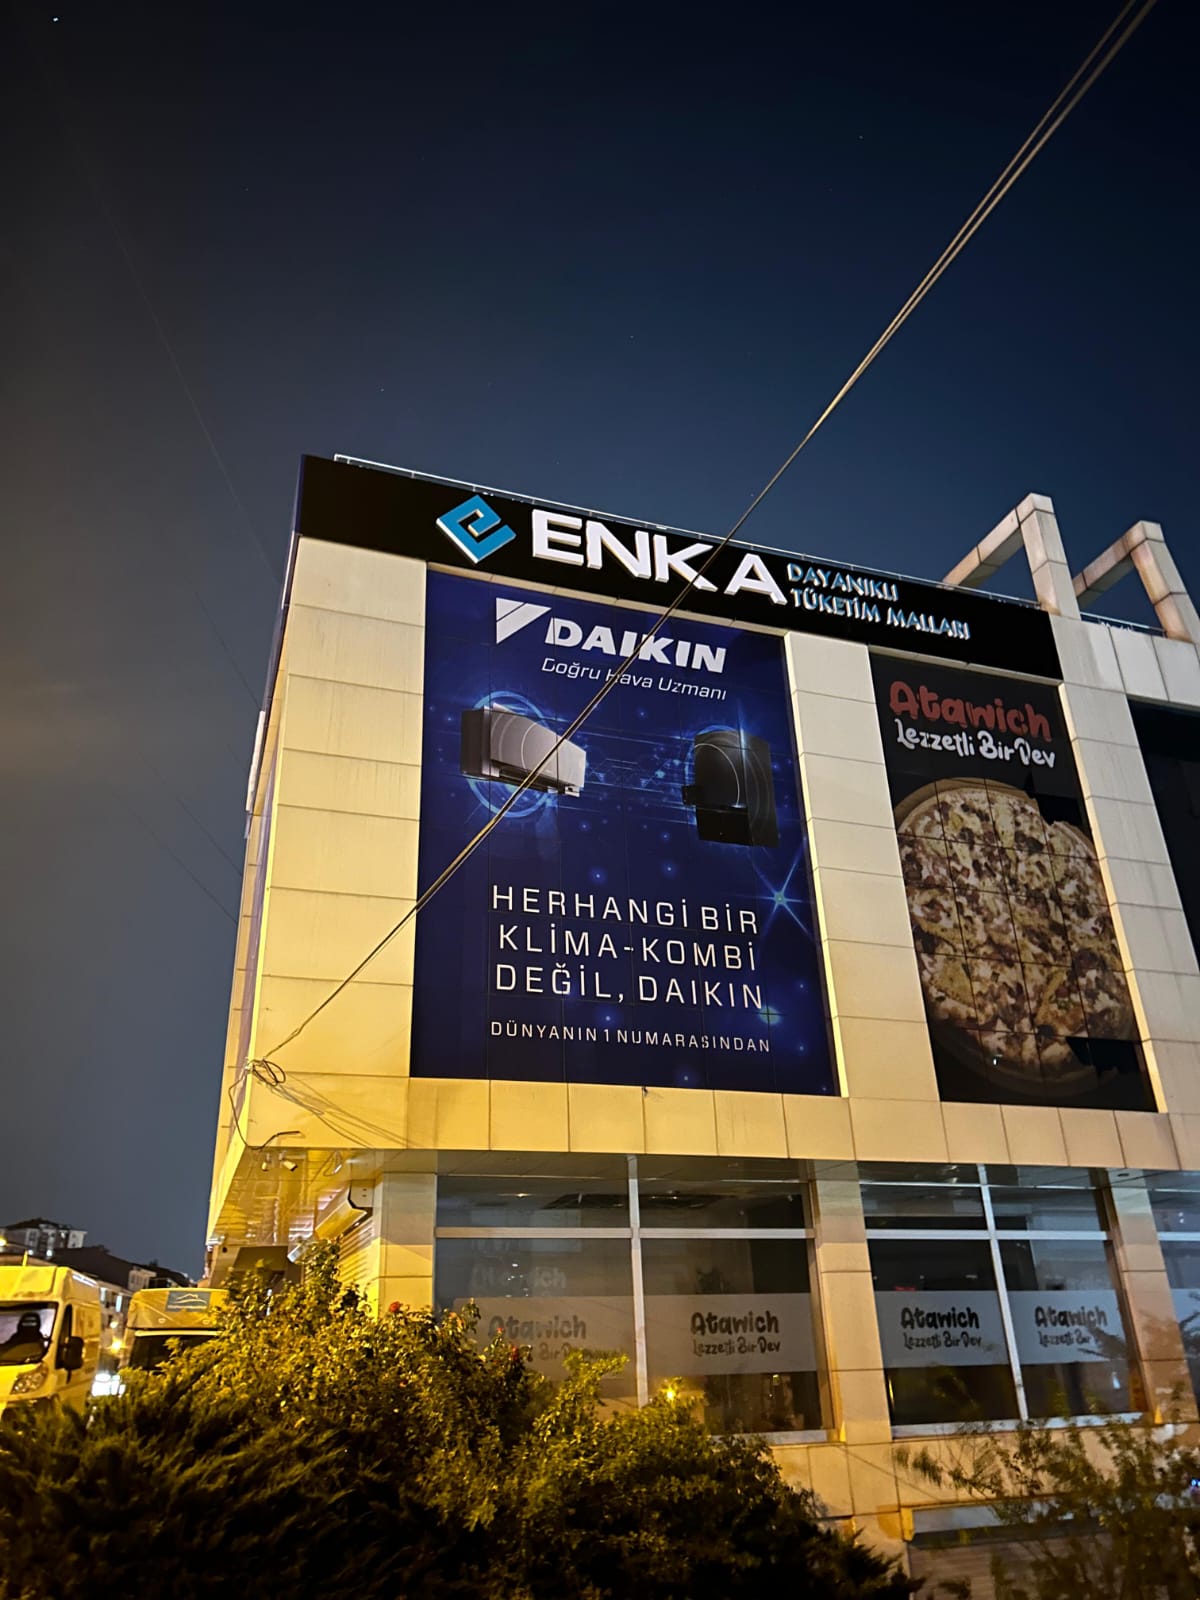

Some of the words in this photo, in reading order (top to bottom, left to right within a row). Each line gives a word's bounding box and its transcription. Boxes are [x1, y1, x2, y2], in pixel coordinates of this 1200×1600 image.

[531, 509, 788, 605] ENKA
[787, 562, 899, 602] DAYANIKLI
[790, 587, 881, 623] TÜKETİM
[886, 607, 971, 640] MALLARI
[545, 618, 727, 673] DAIKIN
[541, 657, 601, 681] Doğru
[605, 668, 653, 689] Hava
[658, 678, 727, 700] Uzmanı
[889, 680, 1052, 742] Atawich
[894, 718, 975, 757] Lezzetli
[976, 730, 1015, 761] Bir
[1014, 737, 1056, 768] Dev
[492, 884, 688, 928] HERHANGİ
[701, 903, 758, 935] BİR
[499, 923, 756, 971] KLİMA-KOMBİ
[495, 962, 625, 1003] DEĞİL,
[638, 975, 763, 1009] DAIKIN
[491, 1019, 597, 1042] DÜNYANIN
[603, 1028, 611, 1044] 1
[616, 1030, 771, 1053] NUMARASINDAN
[690, 1310, 780, 1337] Atawich
[901, 1306, 980, 1330] Atawich
[1034, 1305, 1108, 1329] Atawich
[757, 1335, 781, 1355] Dev
